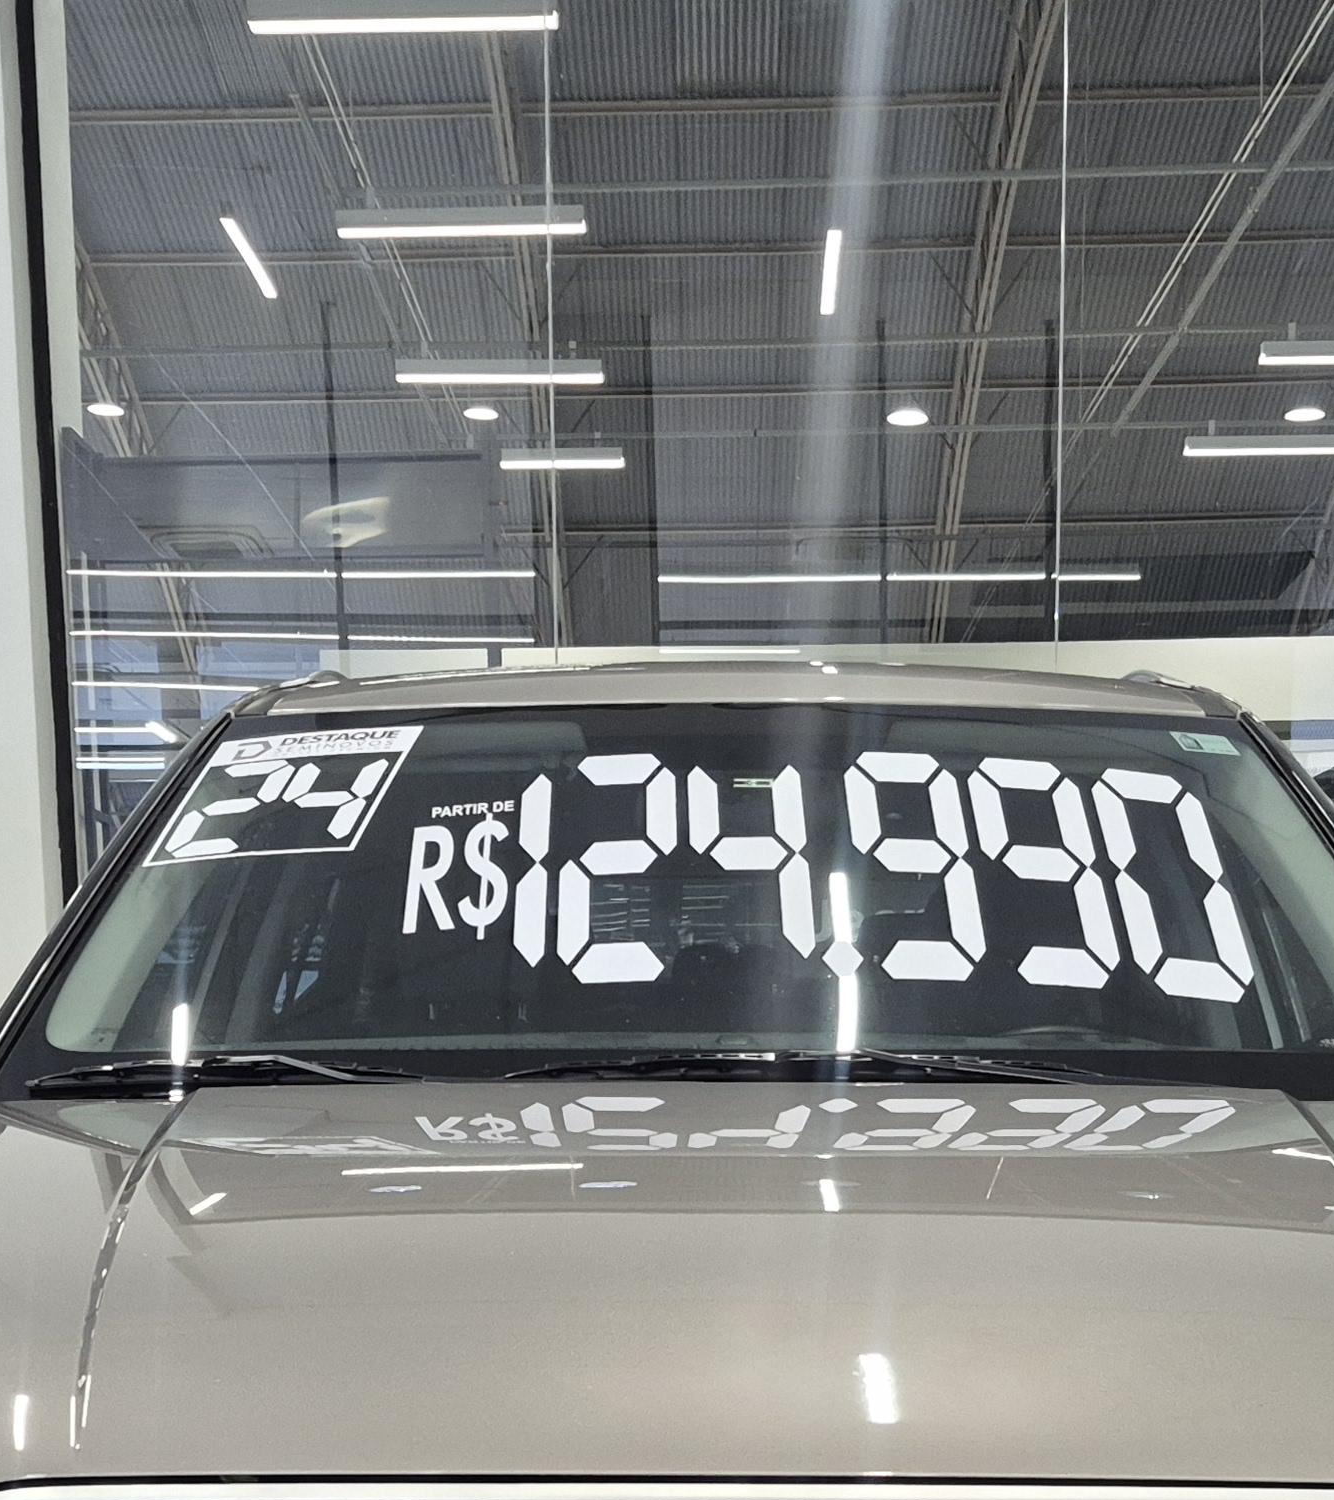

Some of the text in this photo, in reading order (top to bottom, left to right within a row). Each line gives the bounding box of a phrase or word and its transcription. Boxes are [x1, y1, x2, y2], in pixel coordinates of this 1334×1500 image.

[279, 730, 401, 747] DESTAQUE
[164, 758, 390, 858] 24
[431, 799, 515, 819] PARTIR DE
[402, 751, 1255, 1003] R$ 124.990
